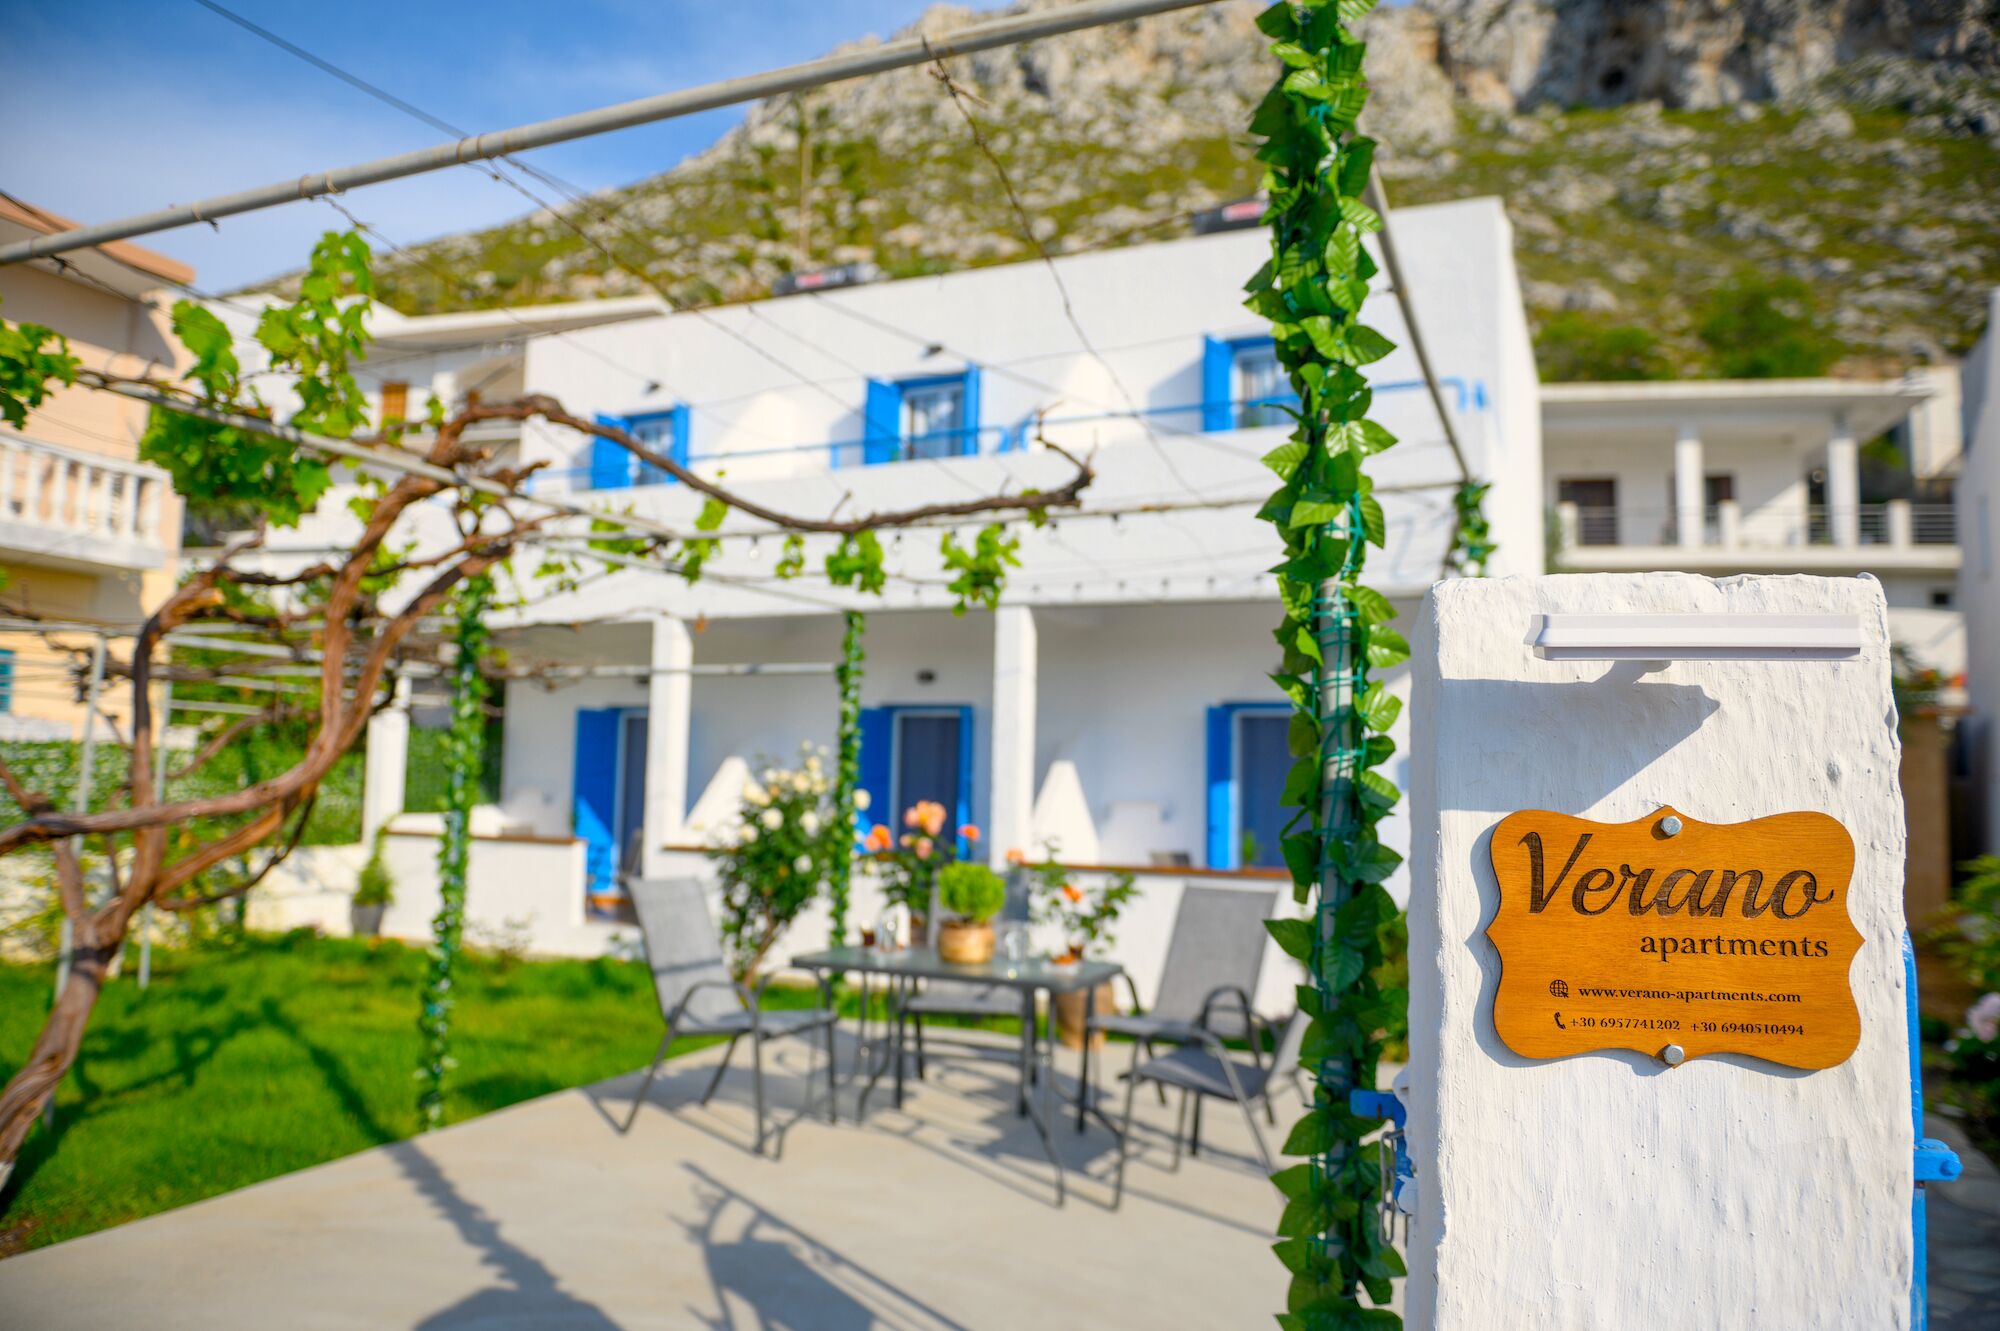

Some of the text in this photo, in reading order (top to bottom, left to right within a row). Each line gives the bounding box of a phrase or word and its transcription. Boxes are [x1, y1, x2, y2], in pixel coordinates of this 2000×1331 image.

[1518, 831, 1834, 920] Verano
[1640, 935, 1828, 962] apartments
[1578, 986, 1802, 1003] www.verano-apartments.com
[1570, 1016, 1804, 1036] +30 6957741202 +30 6940510494
